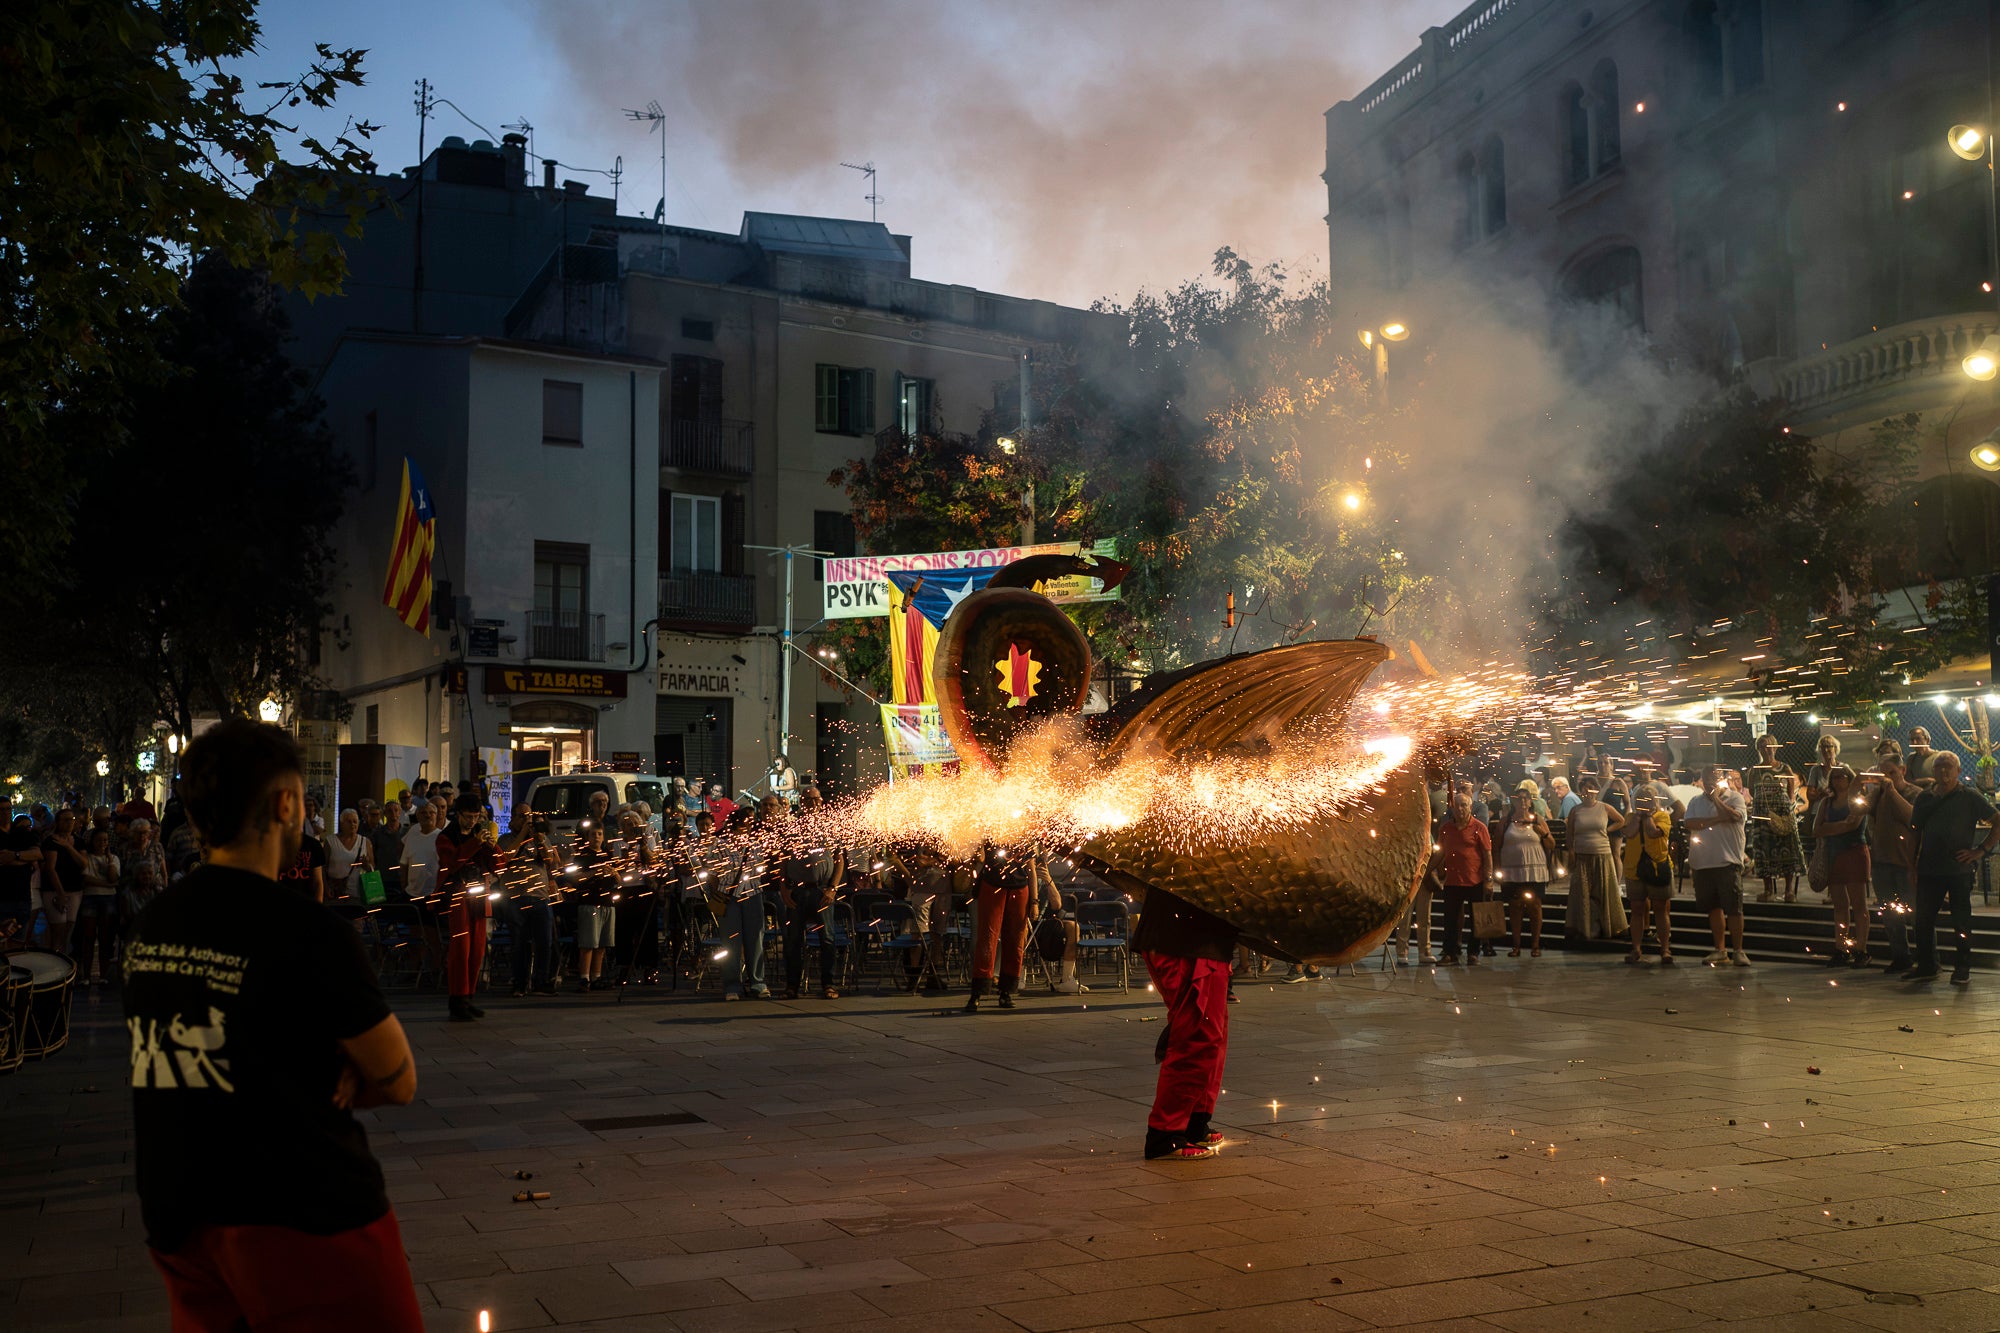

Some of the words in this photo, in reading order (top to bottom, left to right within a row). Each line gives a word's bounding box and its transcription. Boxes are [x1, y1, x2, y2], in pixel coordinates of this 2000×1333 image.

[826, 553, 959, 583] MUTACIONS
[827, 583, 878, 608] PSYK
[531, 671, 604, 688] TABACS
[660, 672, 730, 692] FARMACIA
